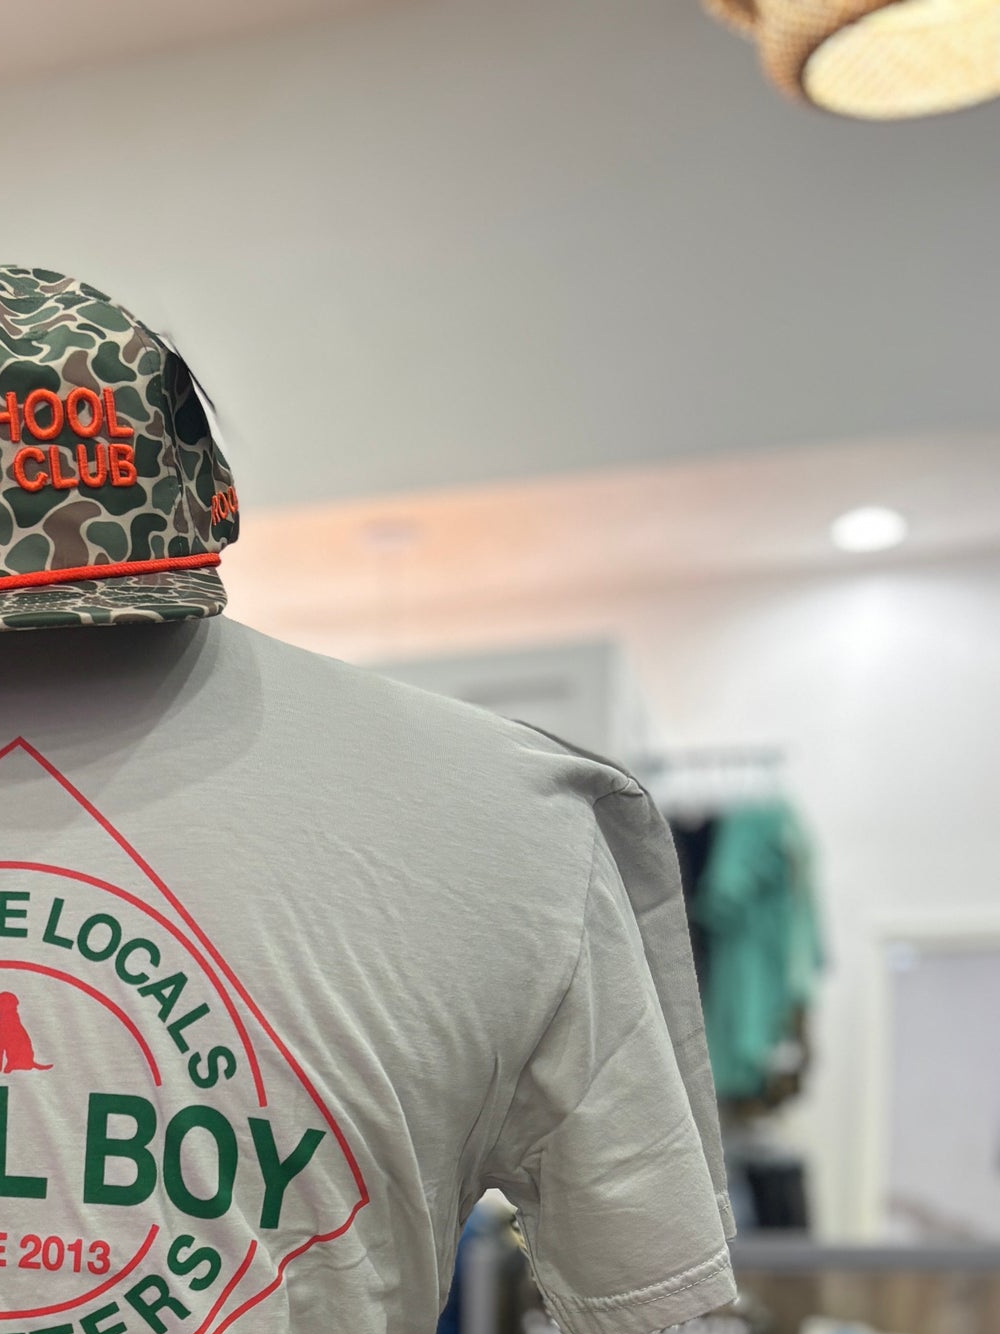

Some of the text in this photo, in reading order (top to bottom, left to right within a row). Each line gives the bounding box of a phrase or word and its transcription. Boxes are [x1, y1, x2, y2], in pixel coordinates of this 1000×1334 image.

[12, 443, 138, 491] CLUB
[43, 897, 237, 1089] LOCALS
[83, 1092, 326, 1230] BOY
[18, 1234, 112, 1275] 2013
